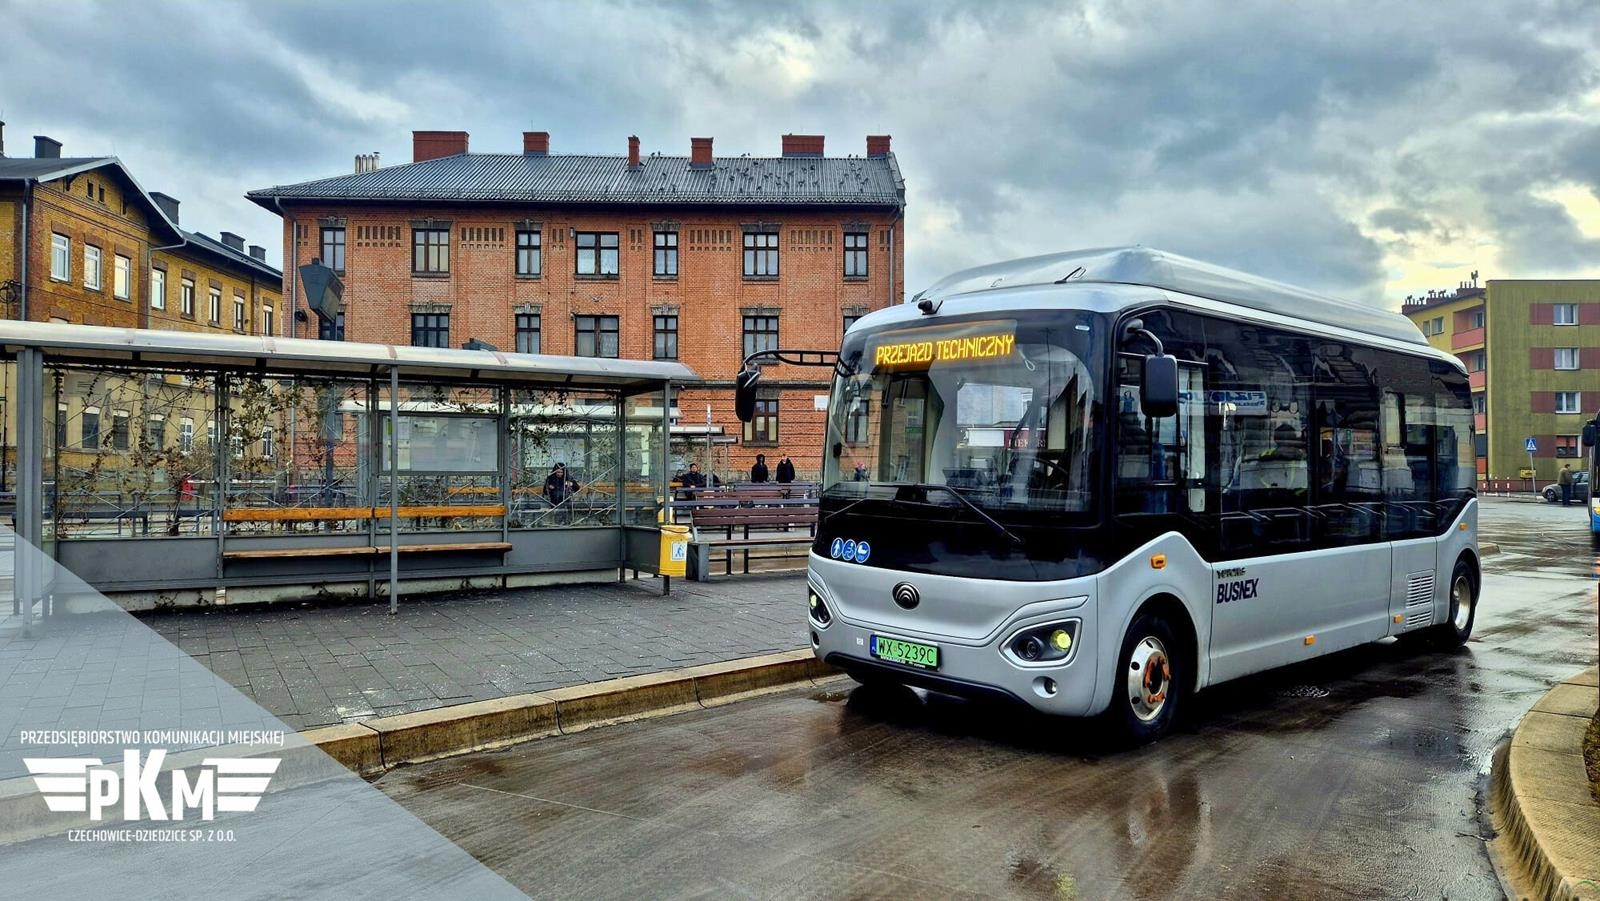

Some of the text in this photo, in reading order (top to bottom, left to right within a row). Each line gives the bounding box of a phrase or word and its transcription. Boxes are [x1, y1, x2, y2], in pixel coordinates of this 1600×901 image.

[876, 334, 1015, 365] PRZEJAZD TECHNICZNY
[1216, 578, 1259, 604] BUSNEX
[878, 638, 893, 656] WX
[897, 642, 934, 664] 5239C
